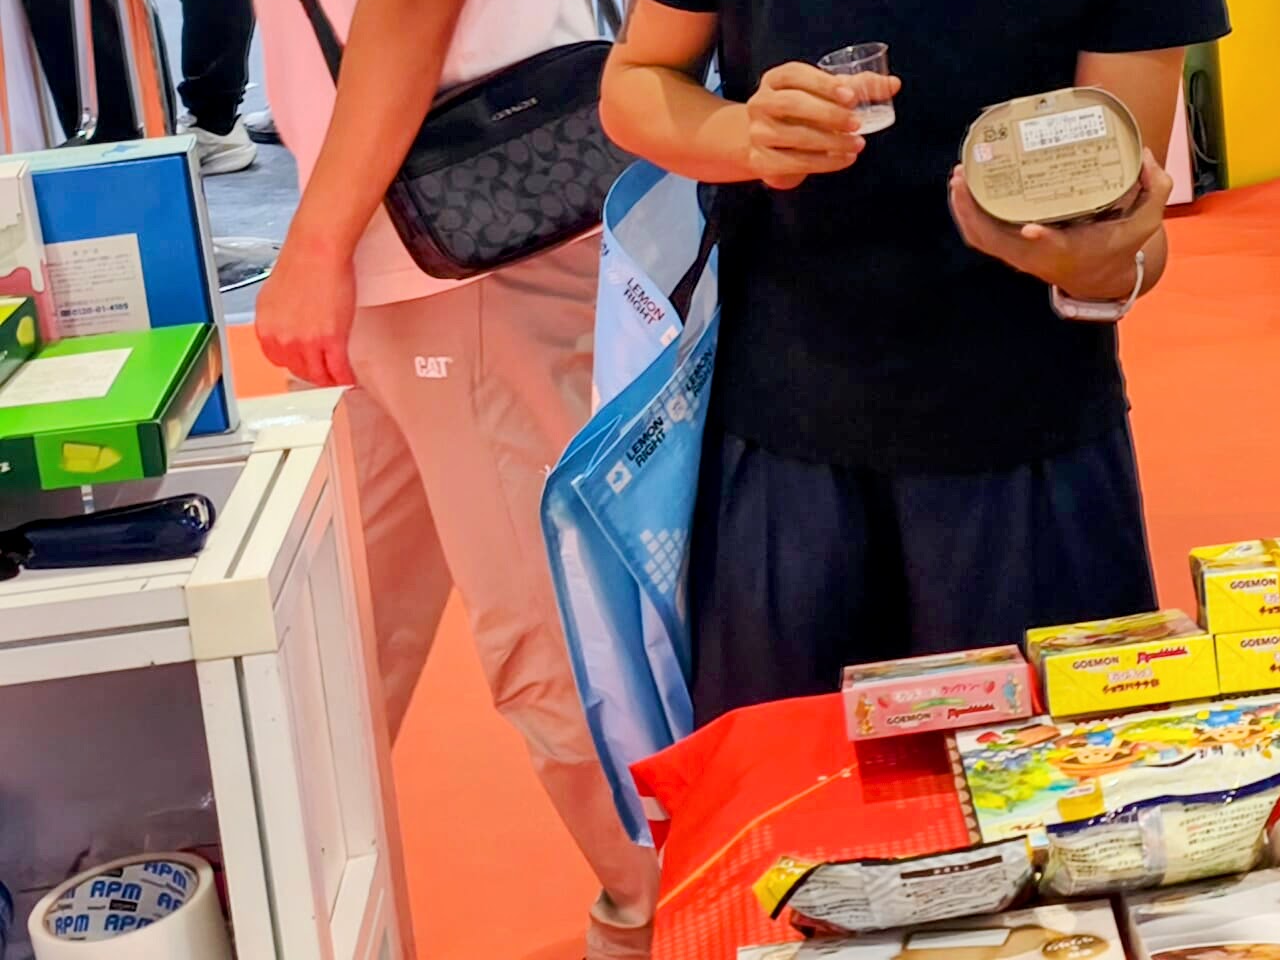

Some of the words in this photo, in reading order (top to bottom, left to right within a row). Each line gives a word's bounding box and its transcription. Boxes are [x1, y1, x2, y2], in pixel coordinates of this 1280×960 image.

[624, 288, 657, 325] RIGHT
[626, 277, 666, 321] LEMON
[414, 356, 449, 378] CAT
[626, 416, 664, 462] LEMON
[635, 429, 666, 468] RIGHT
[1230, 578, 1277, 590] GOEMON
[1072, 656, 1120, 669] GOEMON
[886, 712, 932, 725] GOEMON
[90, 880, 142, 901] APM
[55, 914, 90, 935] APM
